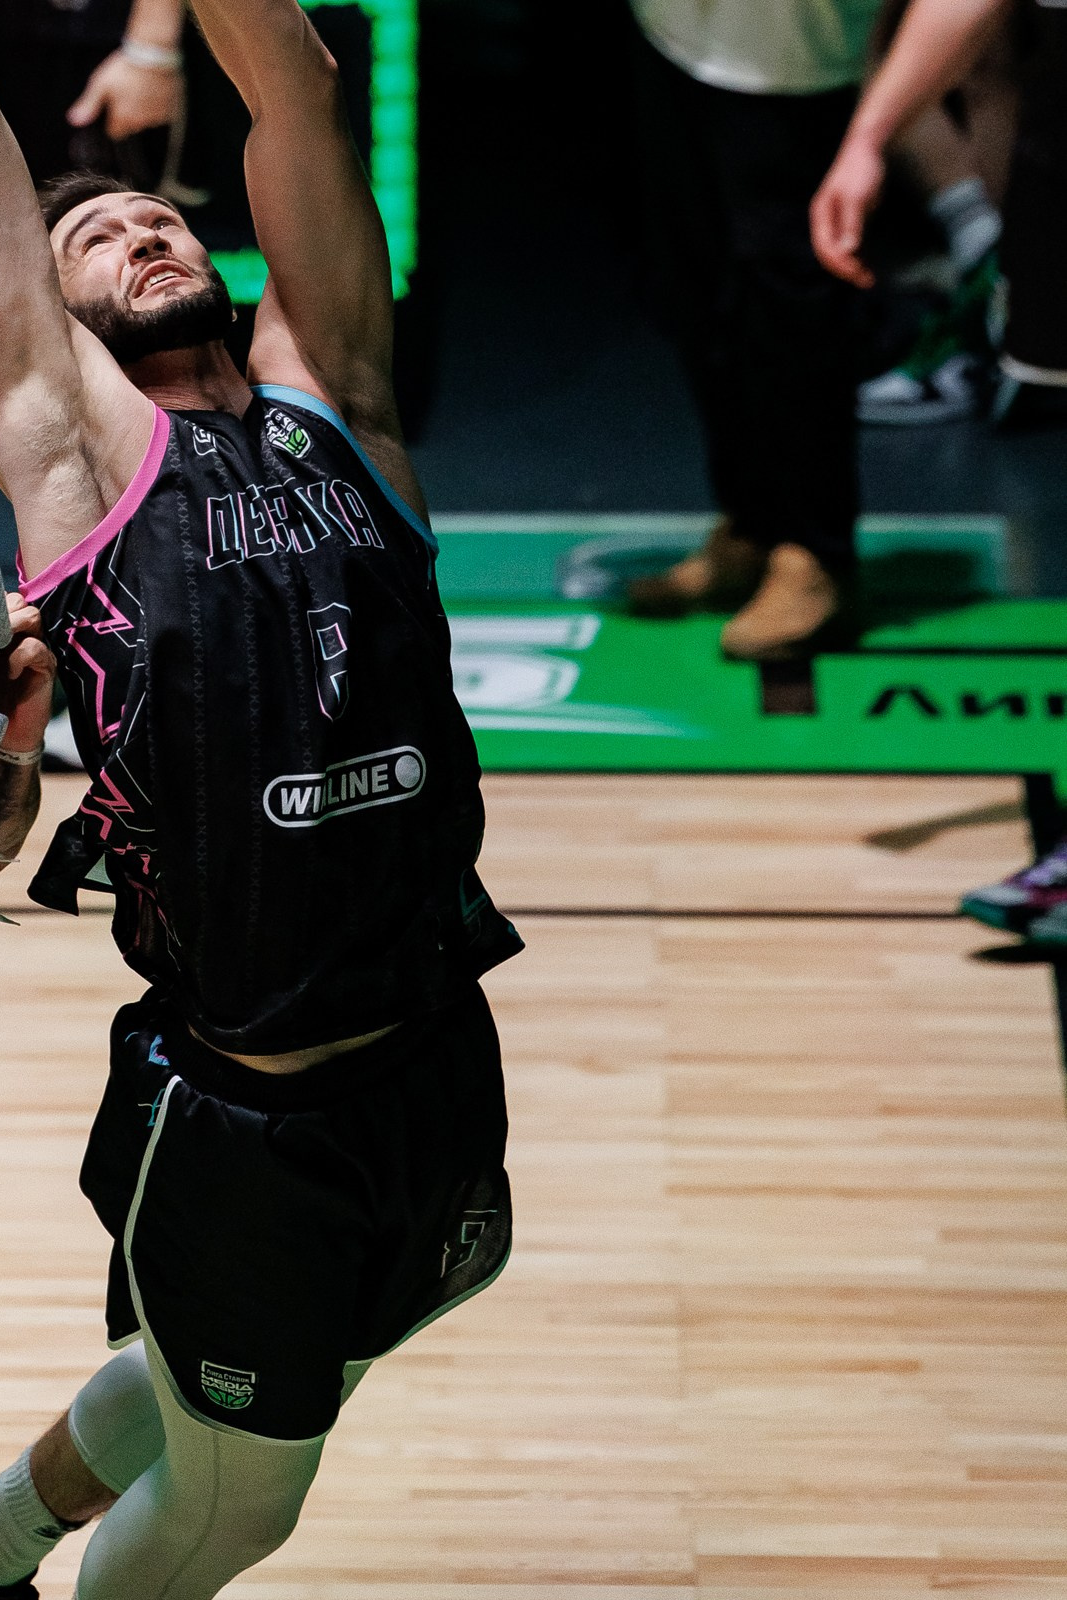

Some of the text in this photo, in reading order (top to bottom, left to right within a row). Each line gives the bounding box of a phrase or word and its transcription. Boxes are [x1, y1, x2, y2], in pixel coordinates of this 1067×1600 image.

[280, 763, 390, 815] WILINE
[201, 1372, 254, 1391] MEDIA
[201, 1378, 255, 1397] BASKET
